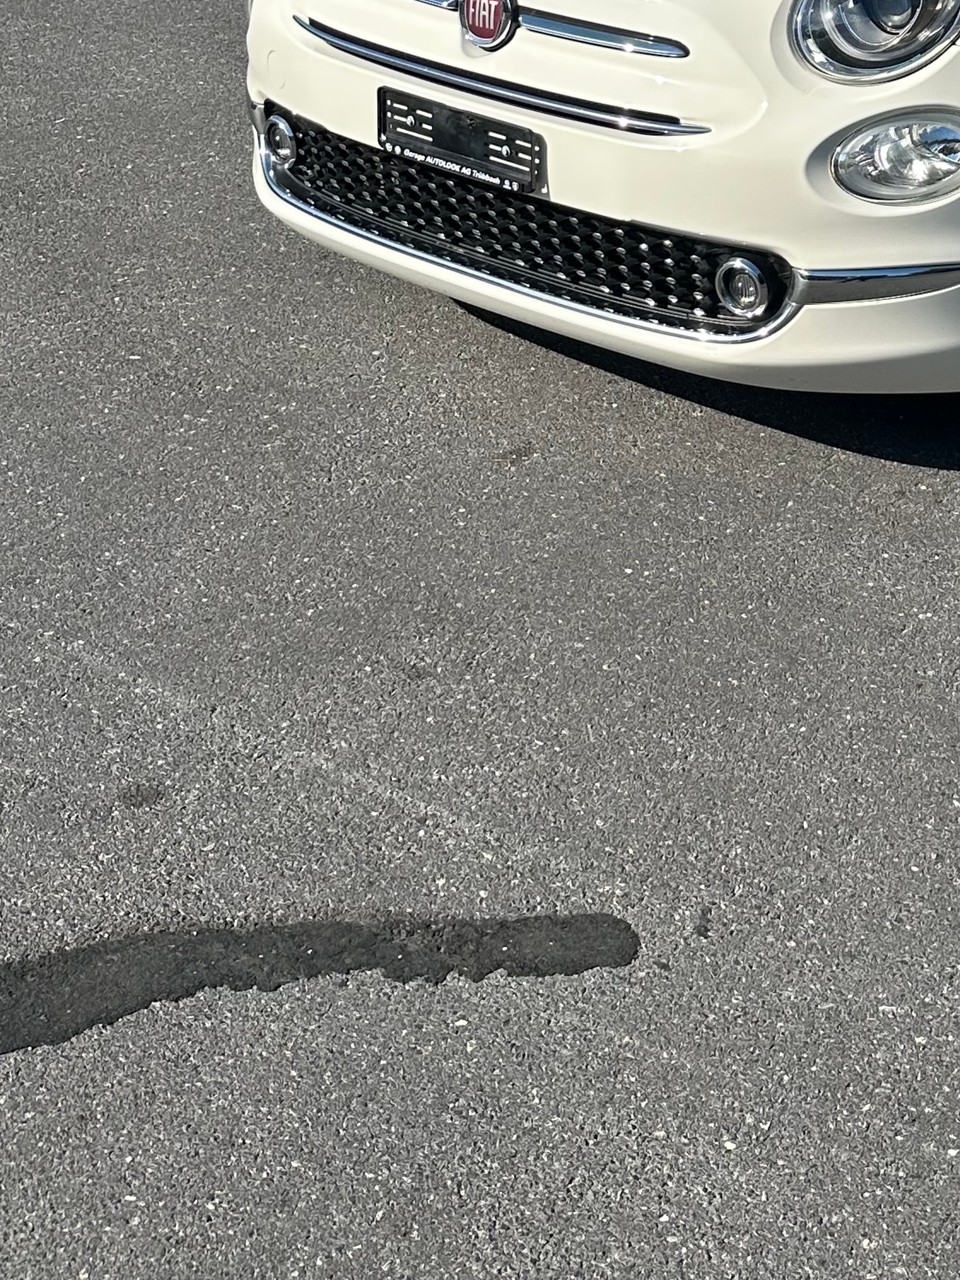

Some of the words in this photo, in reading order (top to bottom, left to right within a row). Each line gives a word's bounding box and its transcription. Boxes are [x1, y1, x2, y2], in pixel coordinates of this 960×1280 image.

[403, 148, 426, 161] Garage
[425, 155, 462, 173] AUTOLOOK
[460, 166, 472, 176] AG
